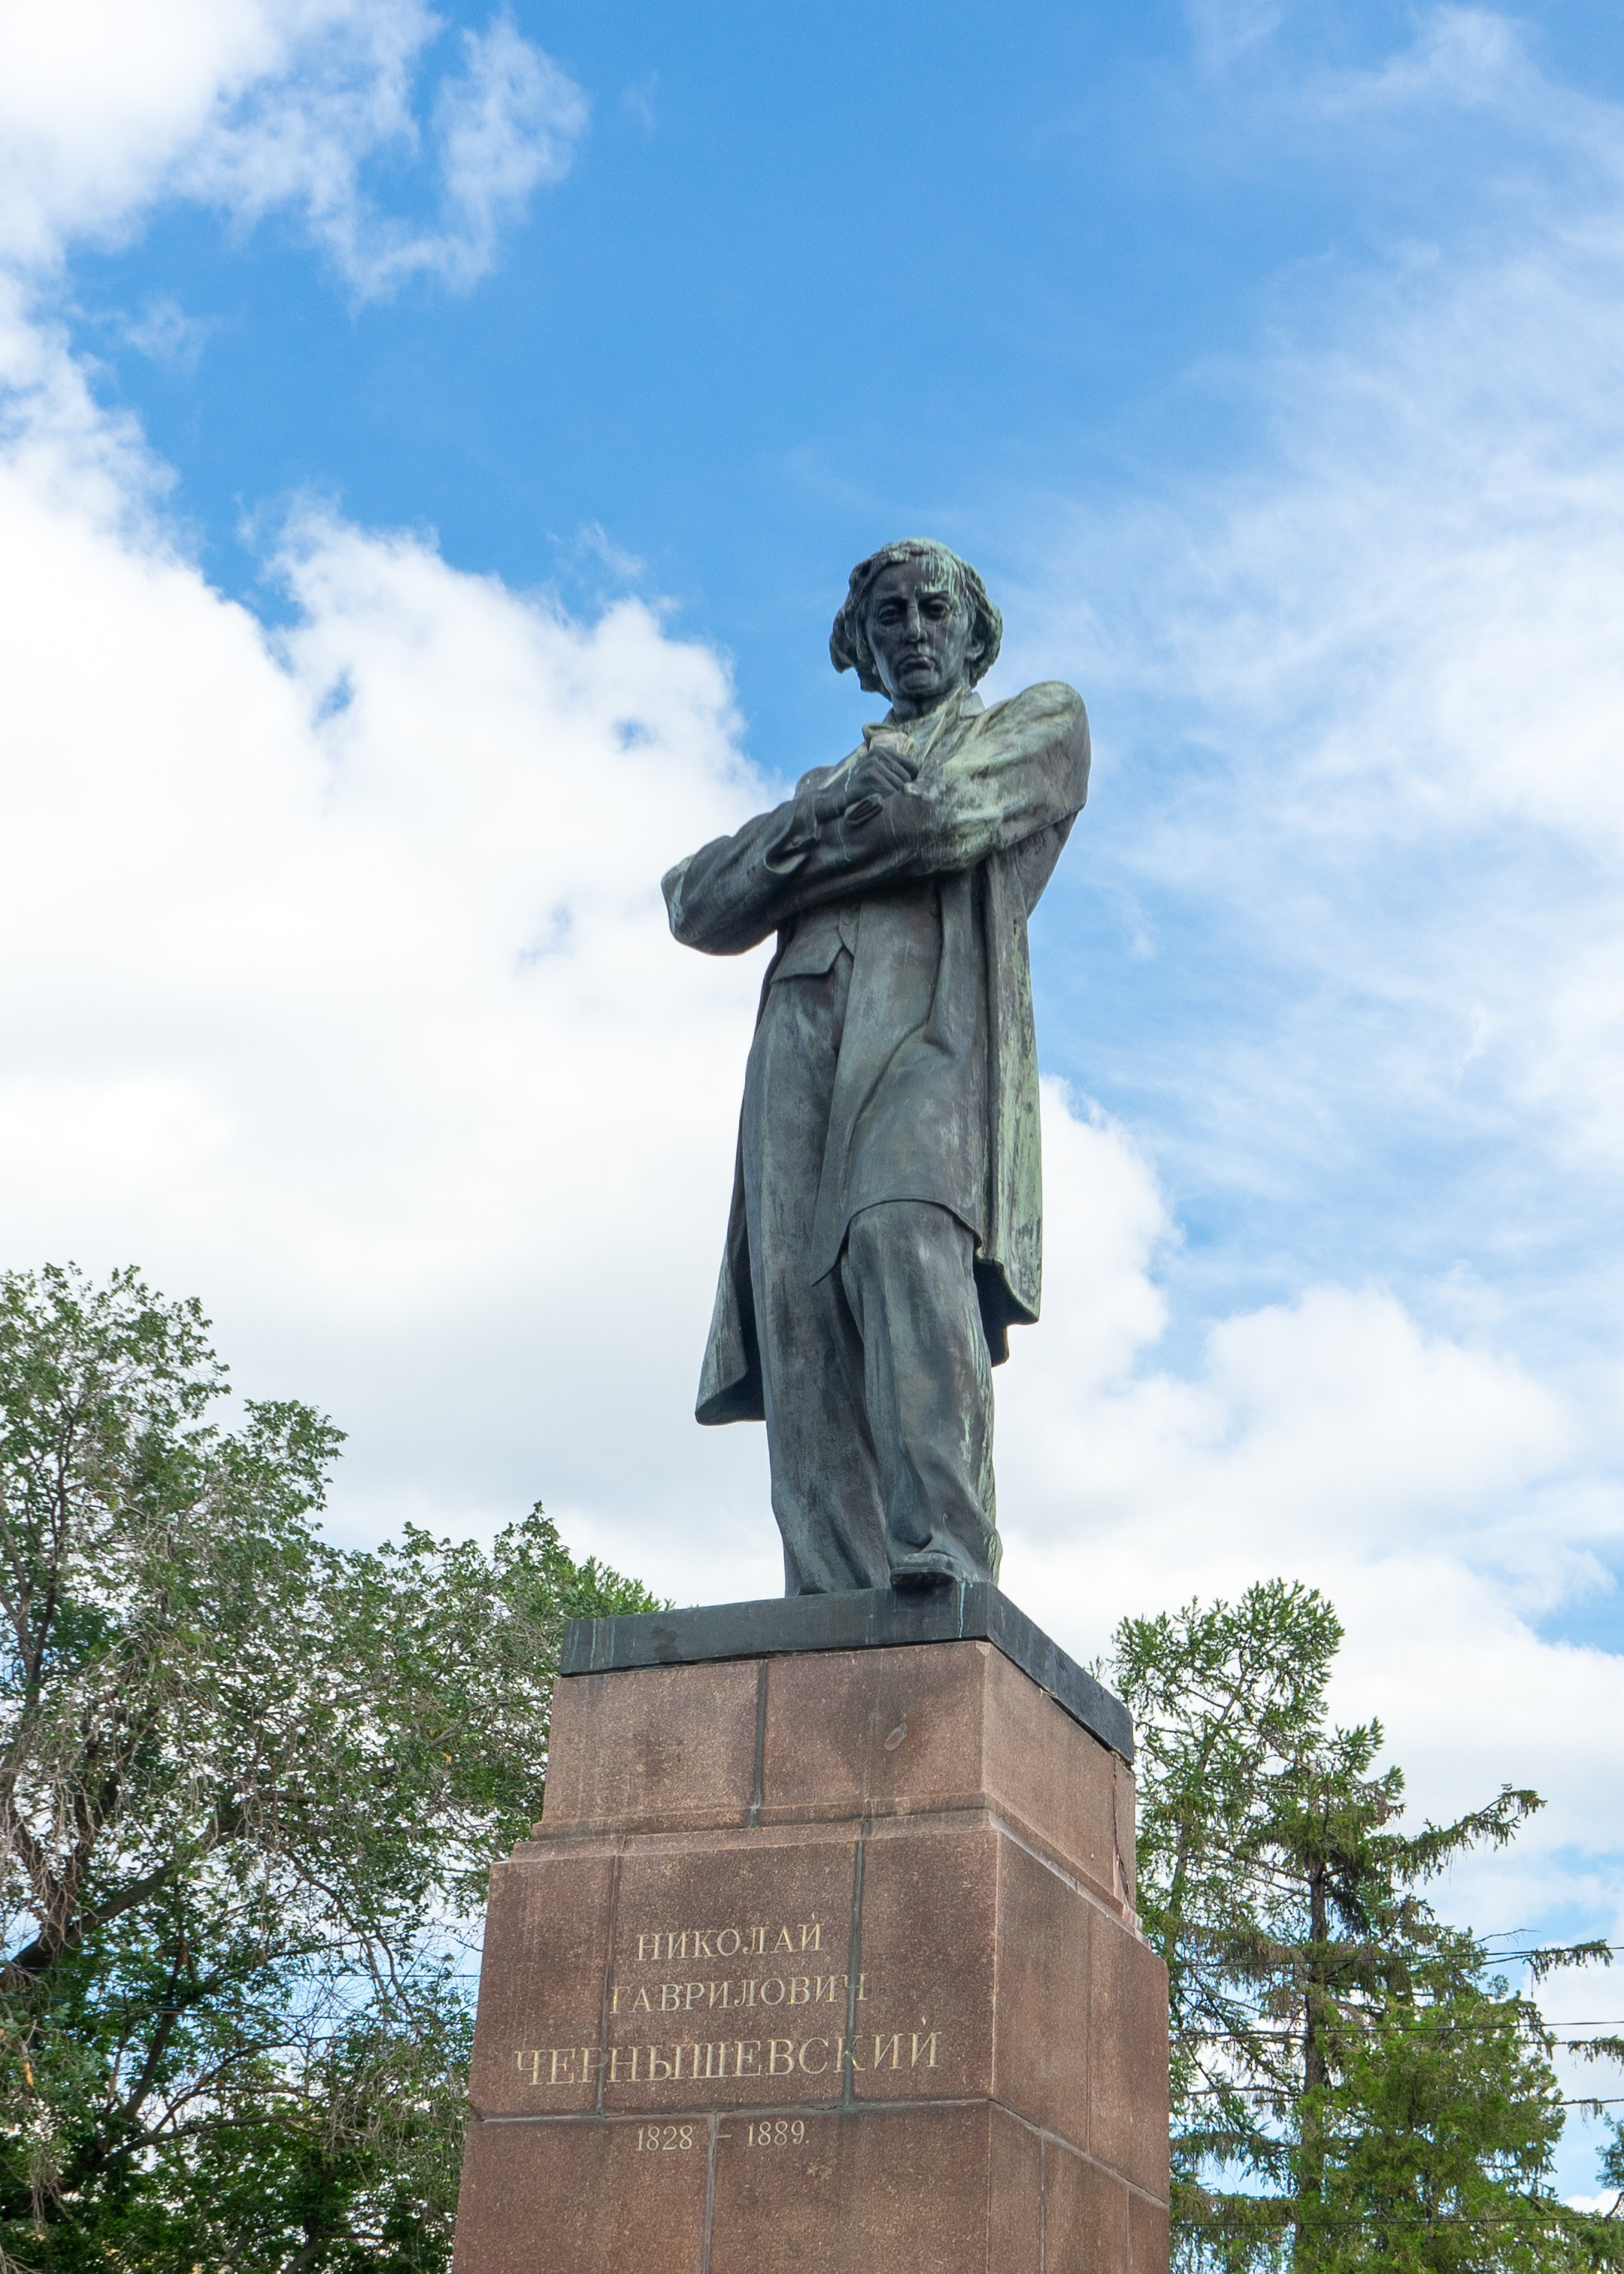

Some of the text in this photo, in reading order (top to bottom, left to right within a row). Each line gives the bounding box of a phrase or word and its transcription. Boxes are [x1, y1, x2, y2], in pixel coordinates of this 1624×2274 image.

[635, 1911, 825, 1961] НИКОЛАЙ
[609, 1972, 868, 2015] ГАВРИЛОВИЧ
[514, 2015, 943, 2086] ЧЕРНЫШЕВСКИЙ
[635, 2124, 694, 2152] 1828
[746, 2120, 810, 2148] 1889.
